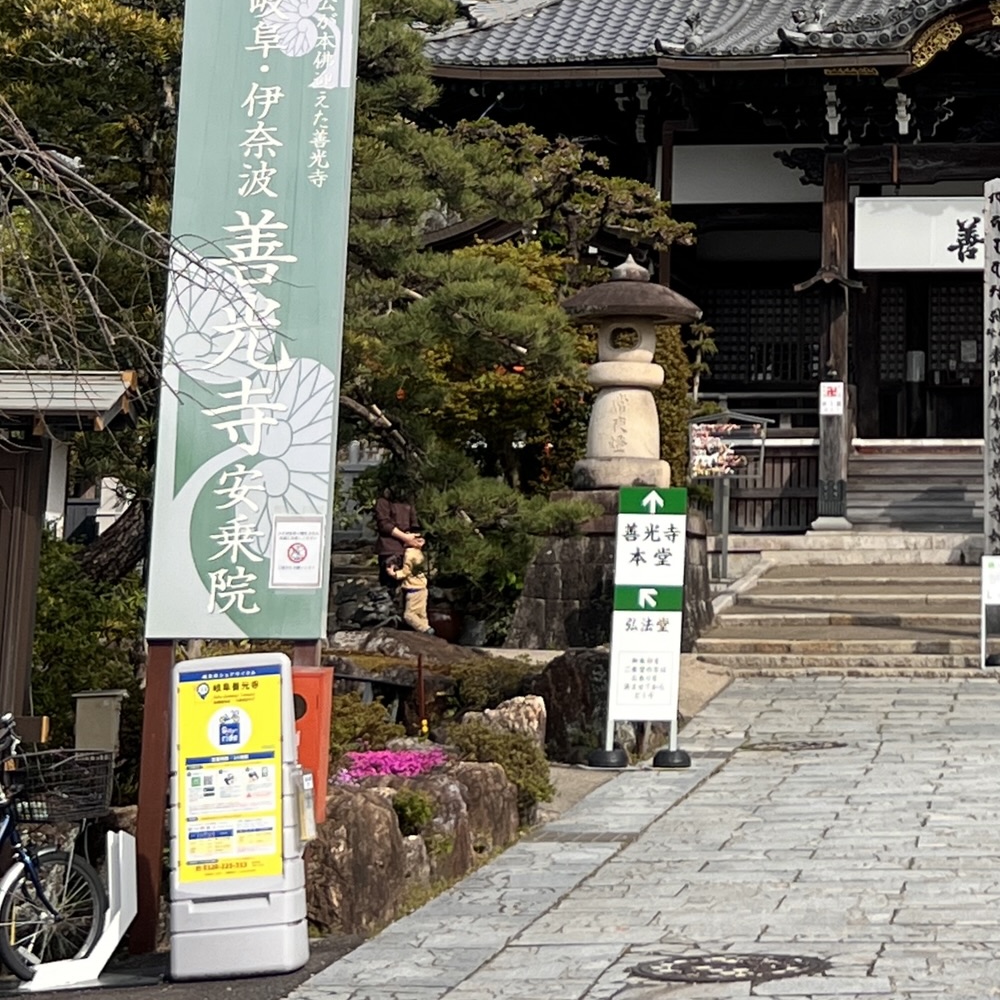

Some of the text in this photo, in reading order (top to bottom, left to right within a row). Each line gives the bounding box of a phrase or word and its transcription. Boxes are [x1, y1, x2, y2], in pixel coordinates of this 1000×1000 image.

[622, 522, 681, 543] 善光寺
[628, 547, 673, 567] 本堂
[625, 617, 670, 633] 弘法堂
